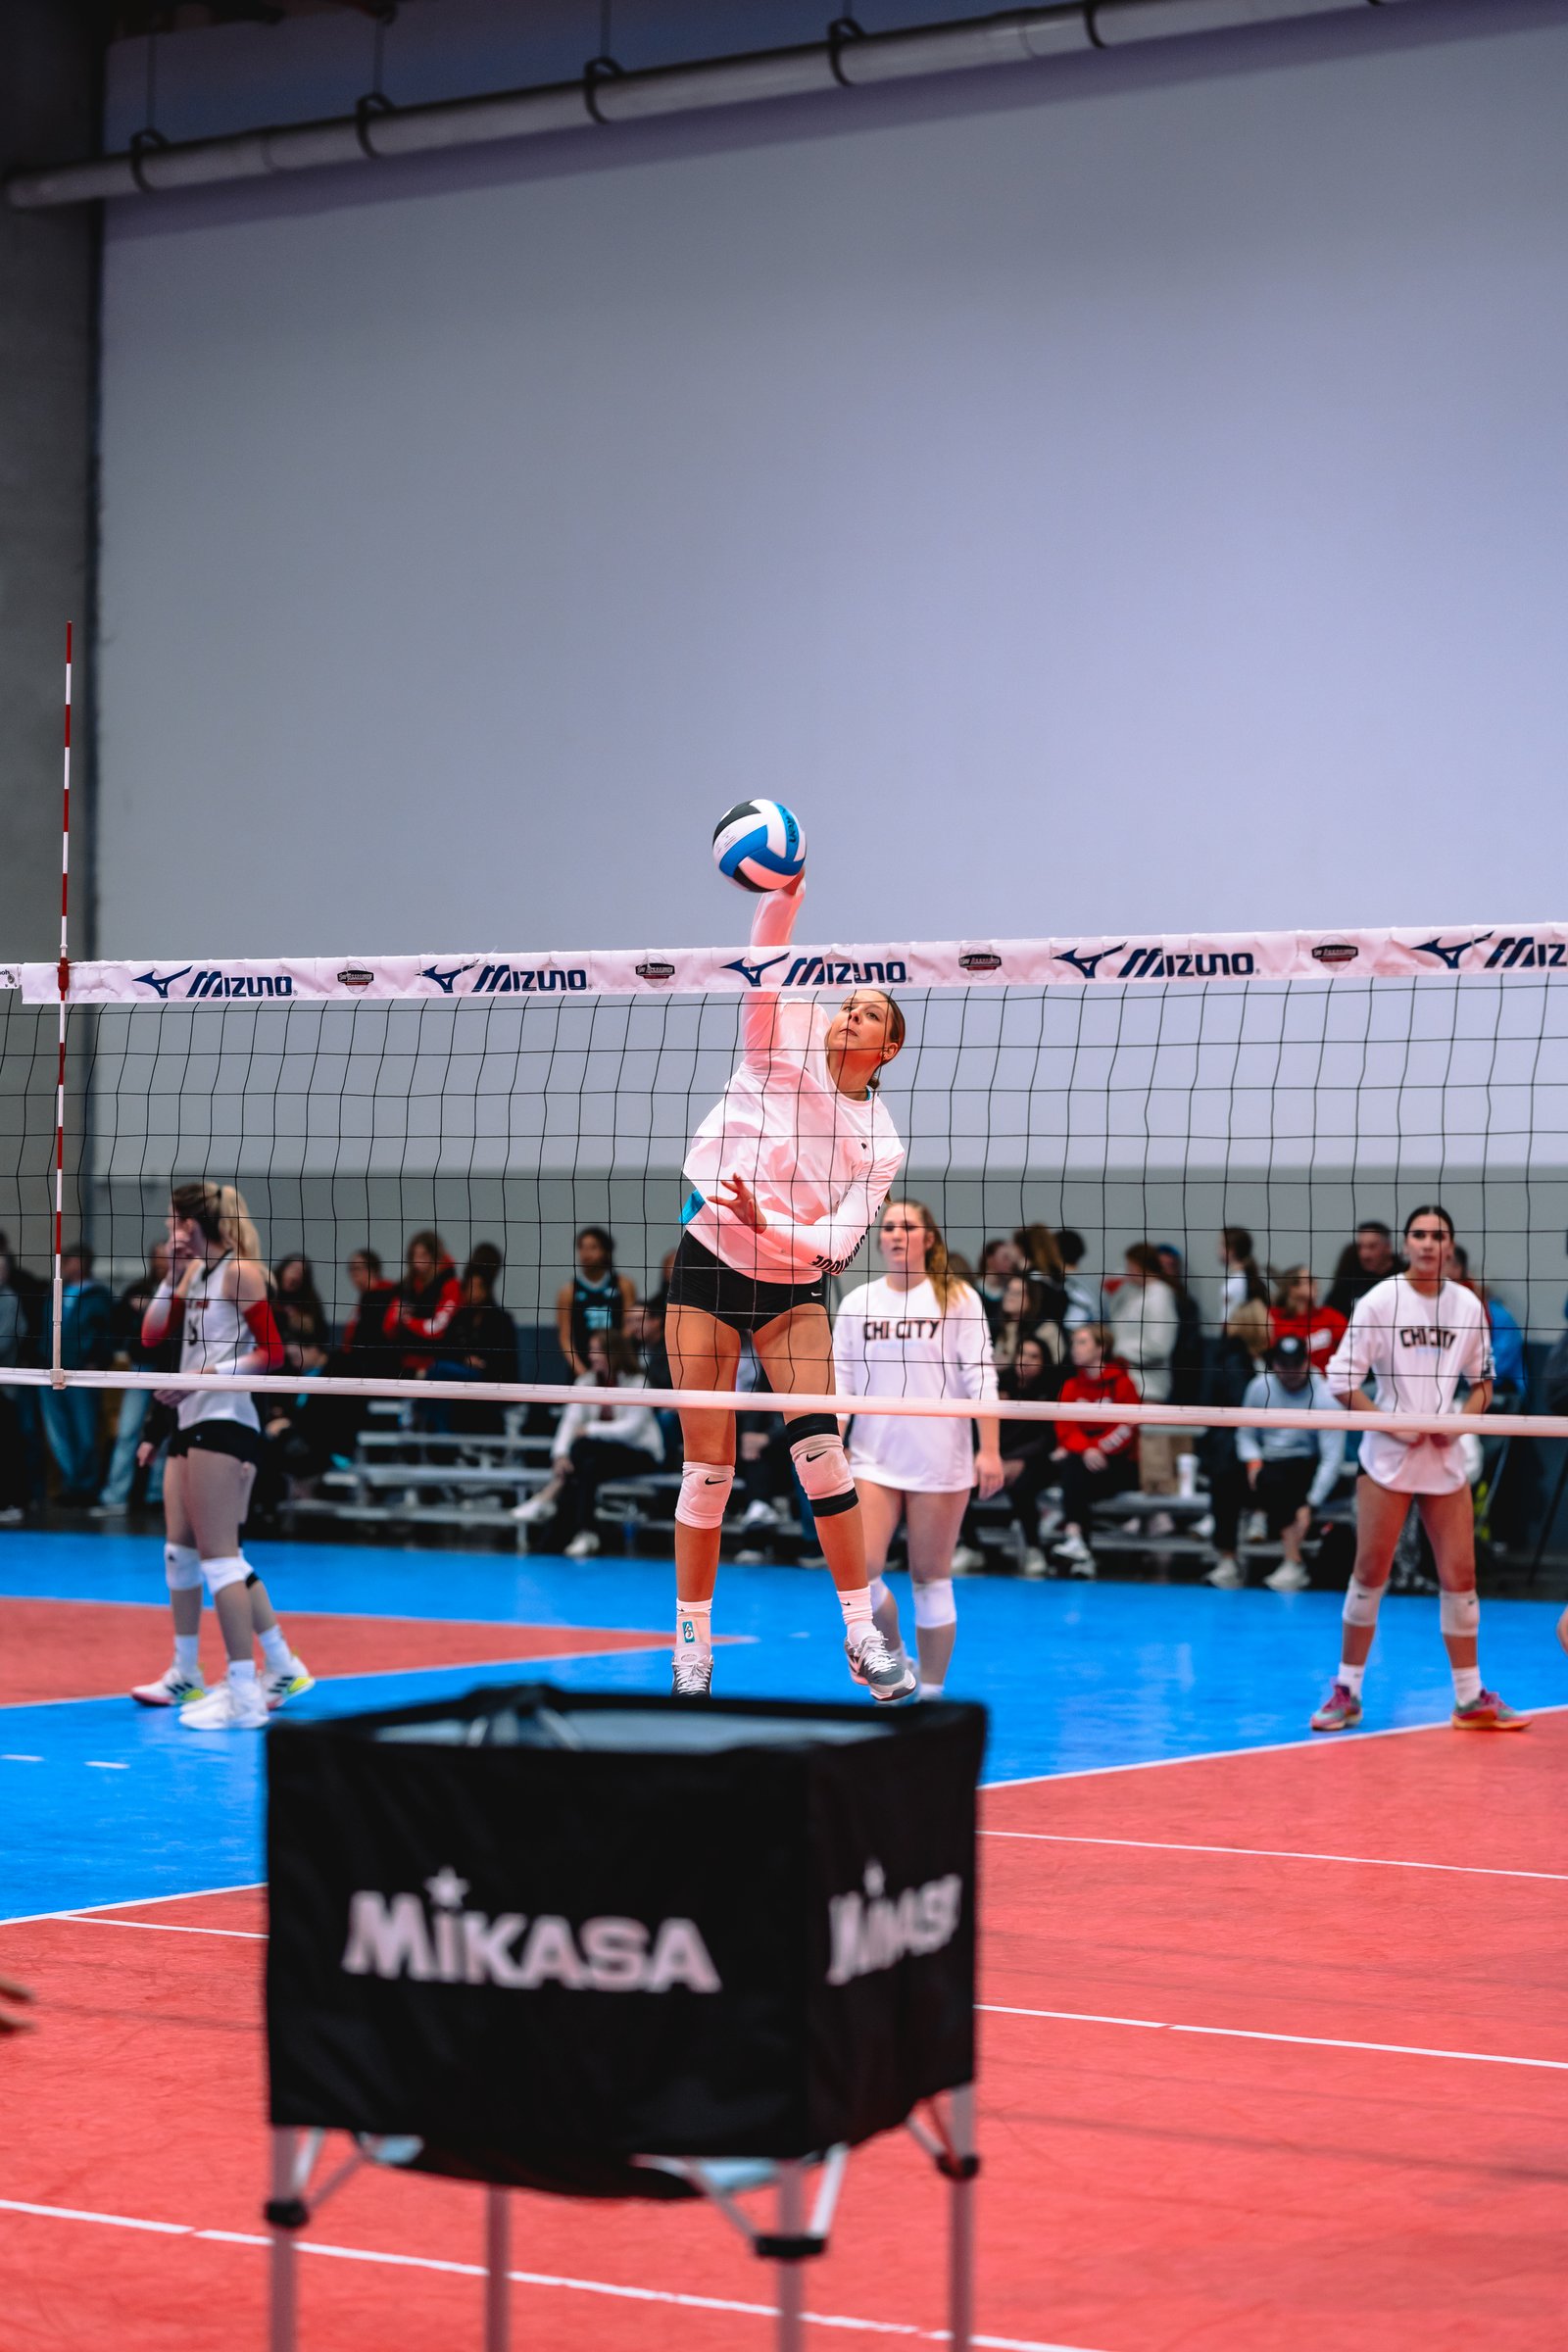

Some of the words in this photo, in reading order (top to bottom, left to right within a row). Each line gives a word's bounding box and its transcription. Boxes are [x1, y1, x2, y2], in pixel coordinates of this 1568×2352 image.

[781, 957, 906, 987] MIZUNO
[1118, 948, 1253, 978] MIZUNO
[186, 970, 293, 998] MIZUNO
[471, 963, 586, 993] MIZUNO
[863, 1320, 890, 1341] CHI
[896, 1320, 939, 1339] CITY
[1399, 1328, 1427, 1348] CHI
